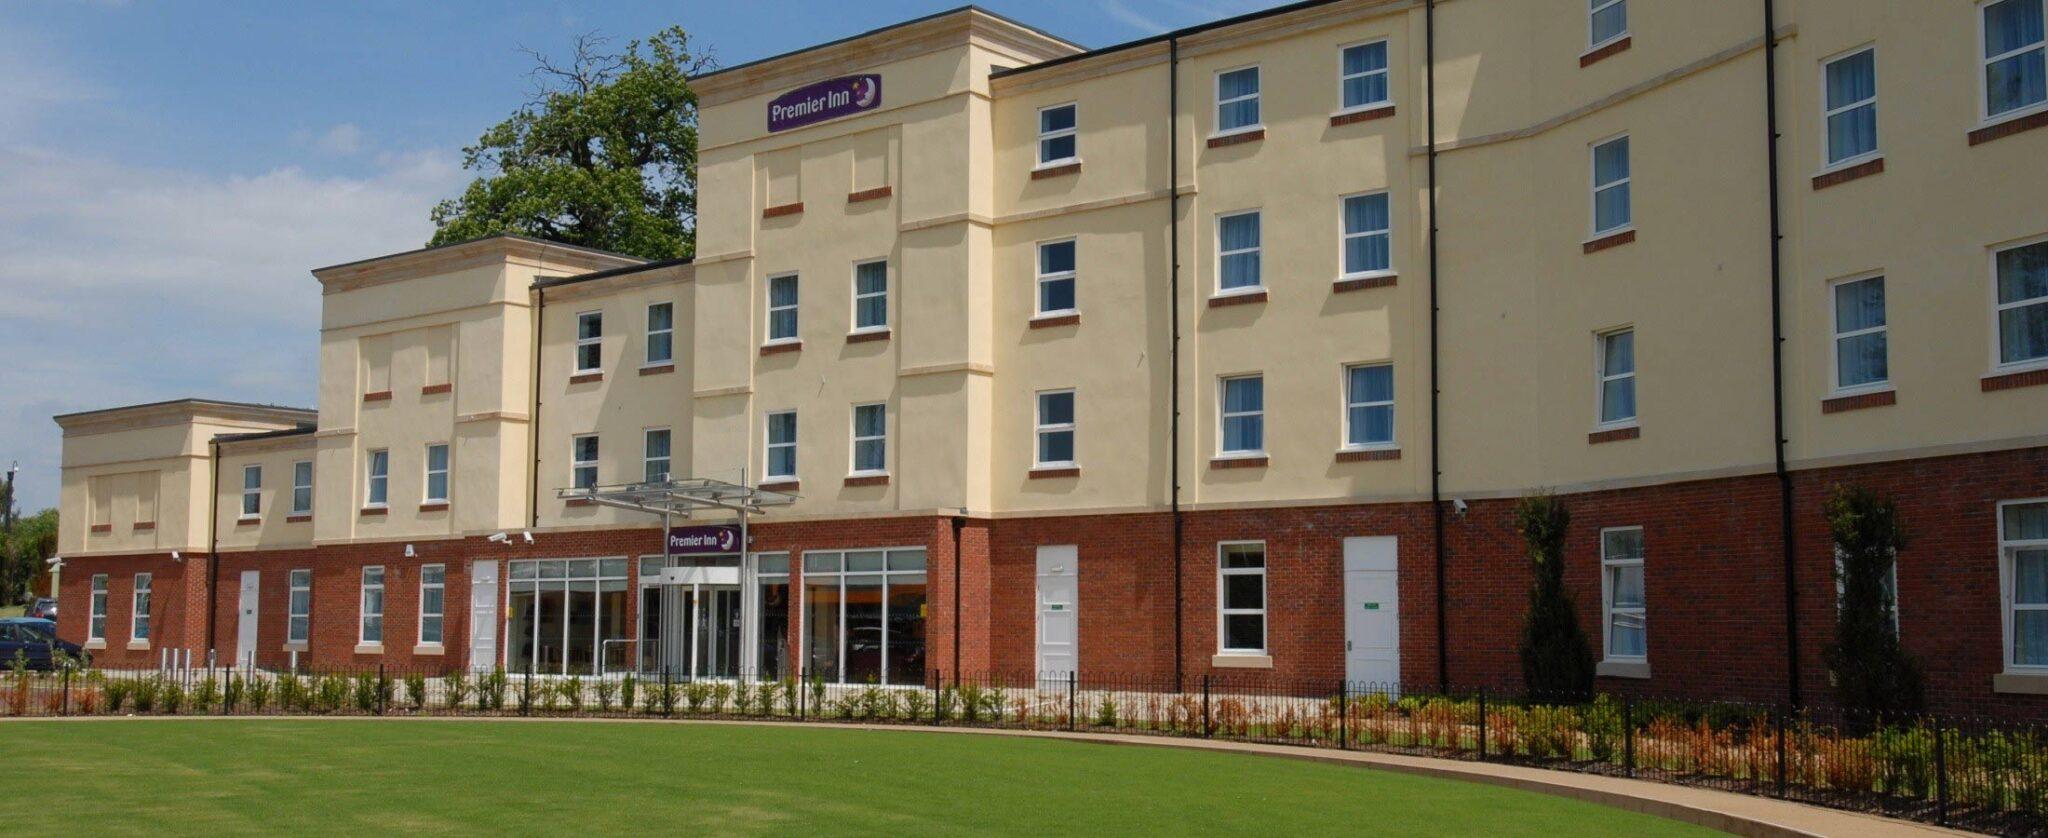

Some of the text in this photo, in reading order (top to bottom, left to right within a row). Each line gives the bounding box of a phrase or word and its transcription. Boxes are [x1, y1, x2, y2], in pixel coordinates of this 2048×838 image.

[772, 90, 850, 122] Premier Inn
[670, 534, 717, 547] Premier Inn
